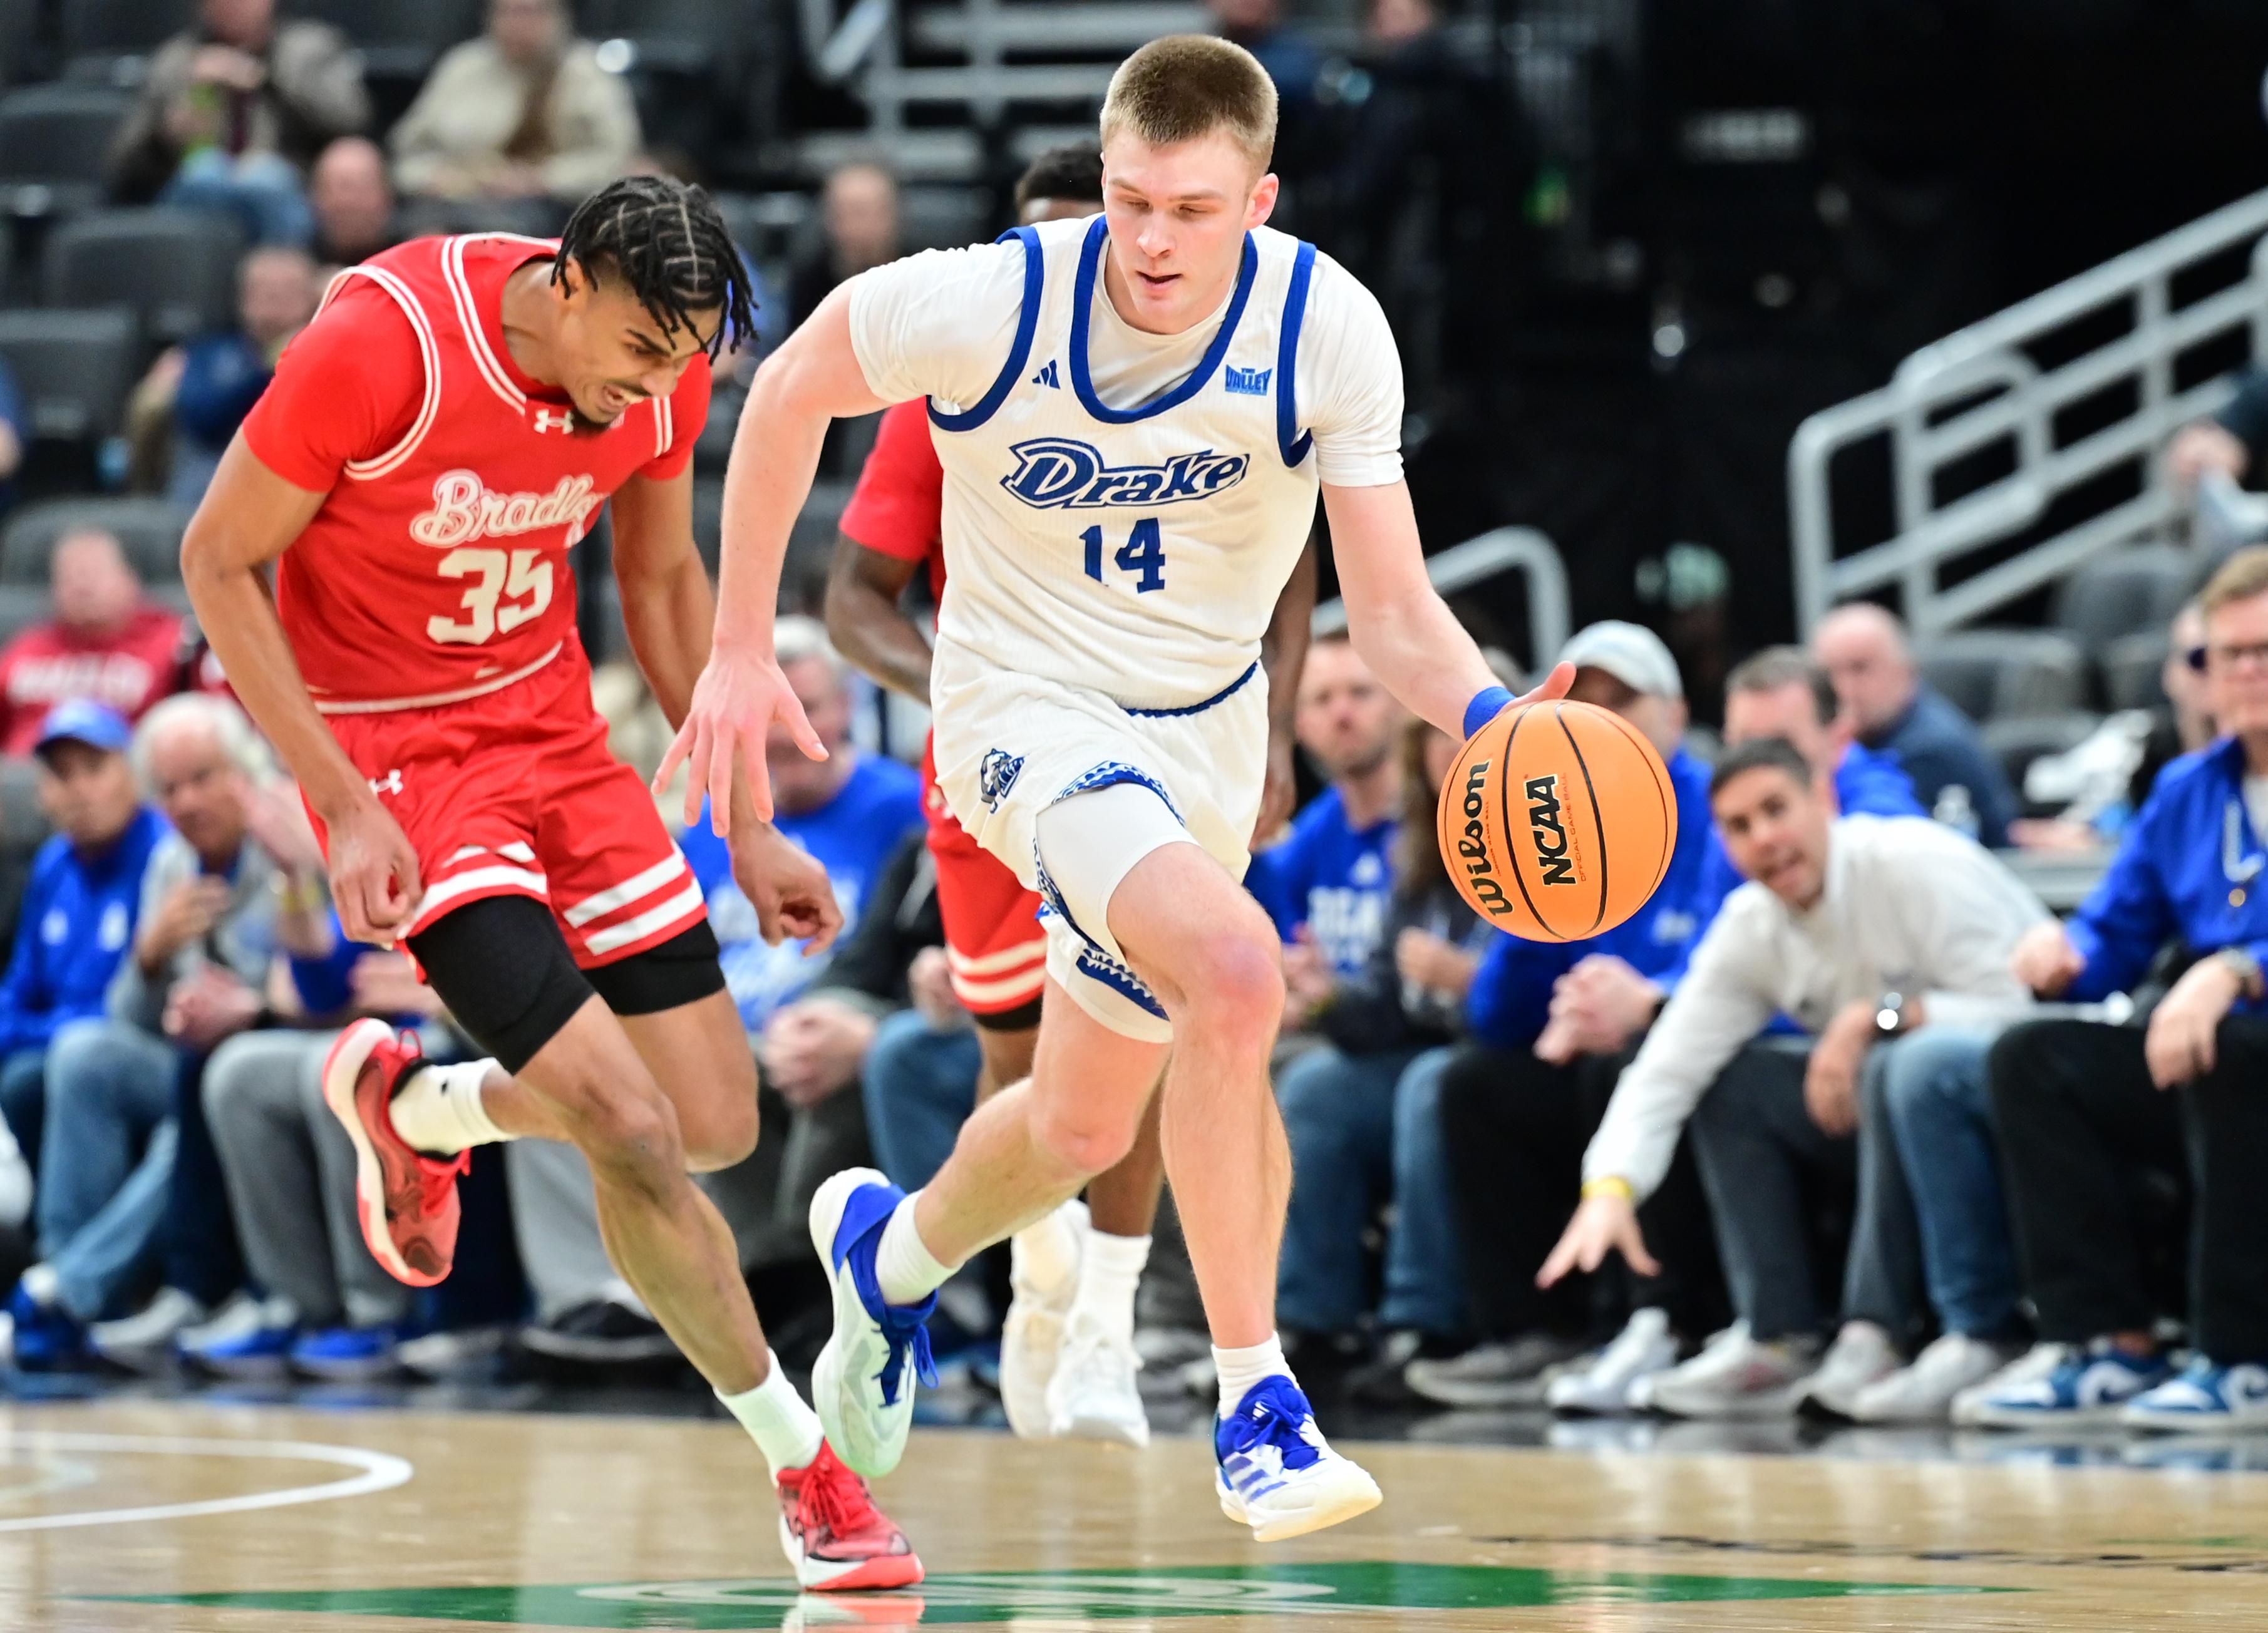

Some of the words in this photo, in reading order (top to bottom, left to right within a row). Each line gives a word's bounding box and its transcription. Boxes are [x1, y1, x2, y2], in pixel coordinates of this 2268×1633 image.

[1225, 364, 1273, 391] VALLEY
[1000, 437, 1250, 509] Drake
[1079, 517, 1166, 594] 14
[426, 548, 554, 646] 35
[1561, 772, 1570, 800] BALL
[1566, 803, 1576, 835] GAME
[1458, 758, 1515, 917] Wilson
[1523, 773, 1578, 887] NCAA
[1574, 837, 1587, 882] OFFICIAL
